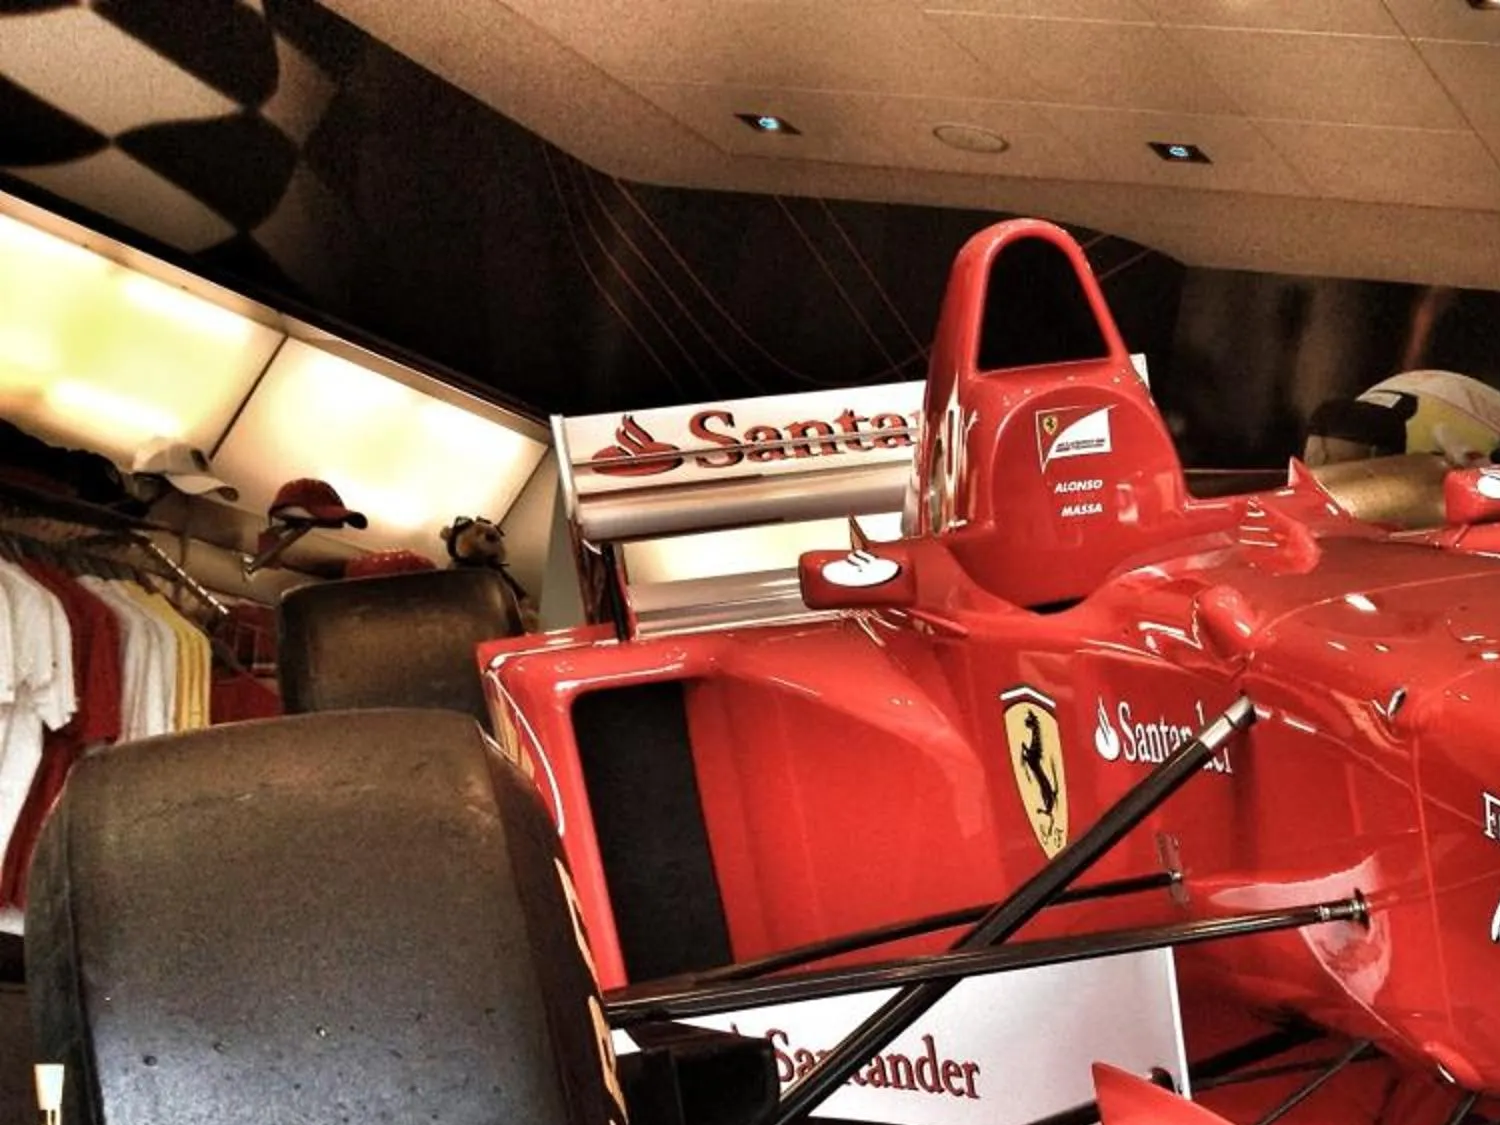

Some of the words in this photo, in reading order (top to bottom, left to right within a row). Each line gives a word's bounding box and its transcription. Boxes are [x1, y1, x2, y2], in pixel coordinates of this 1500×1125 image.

[689, 408, 922, 469] Santa
[1054, 479, 1103, 495] ALONSO
[1061, 502, 1103, 517] MASSA
